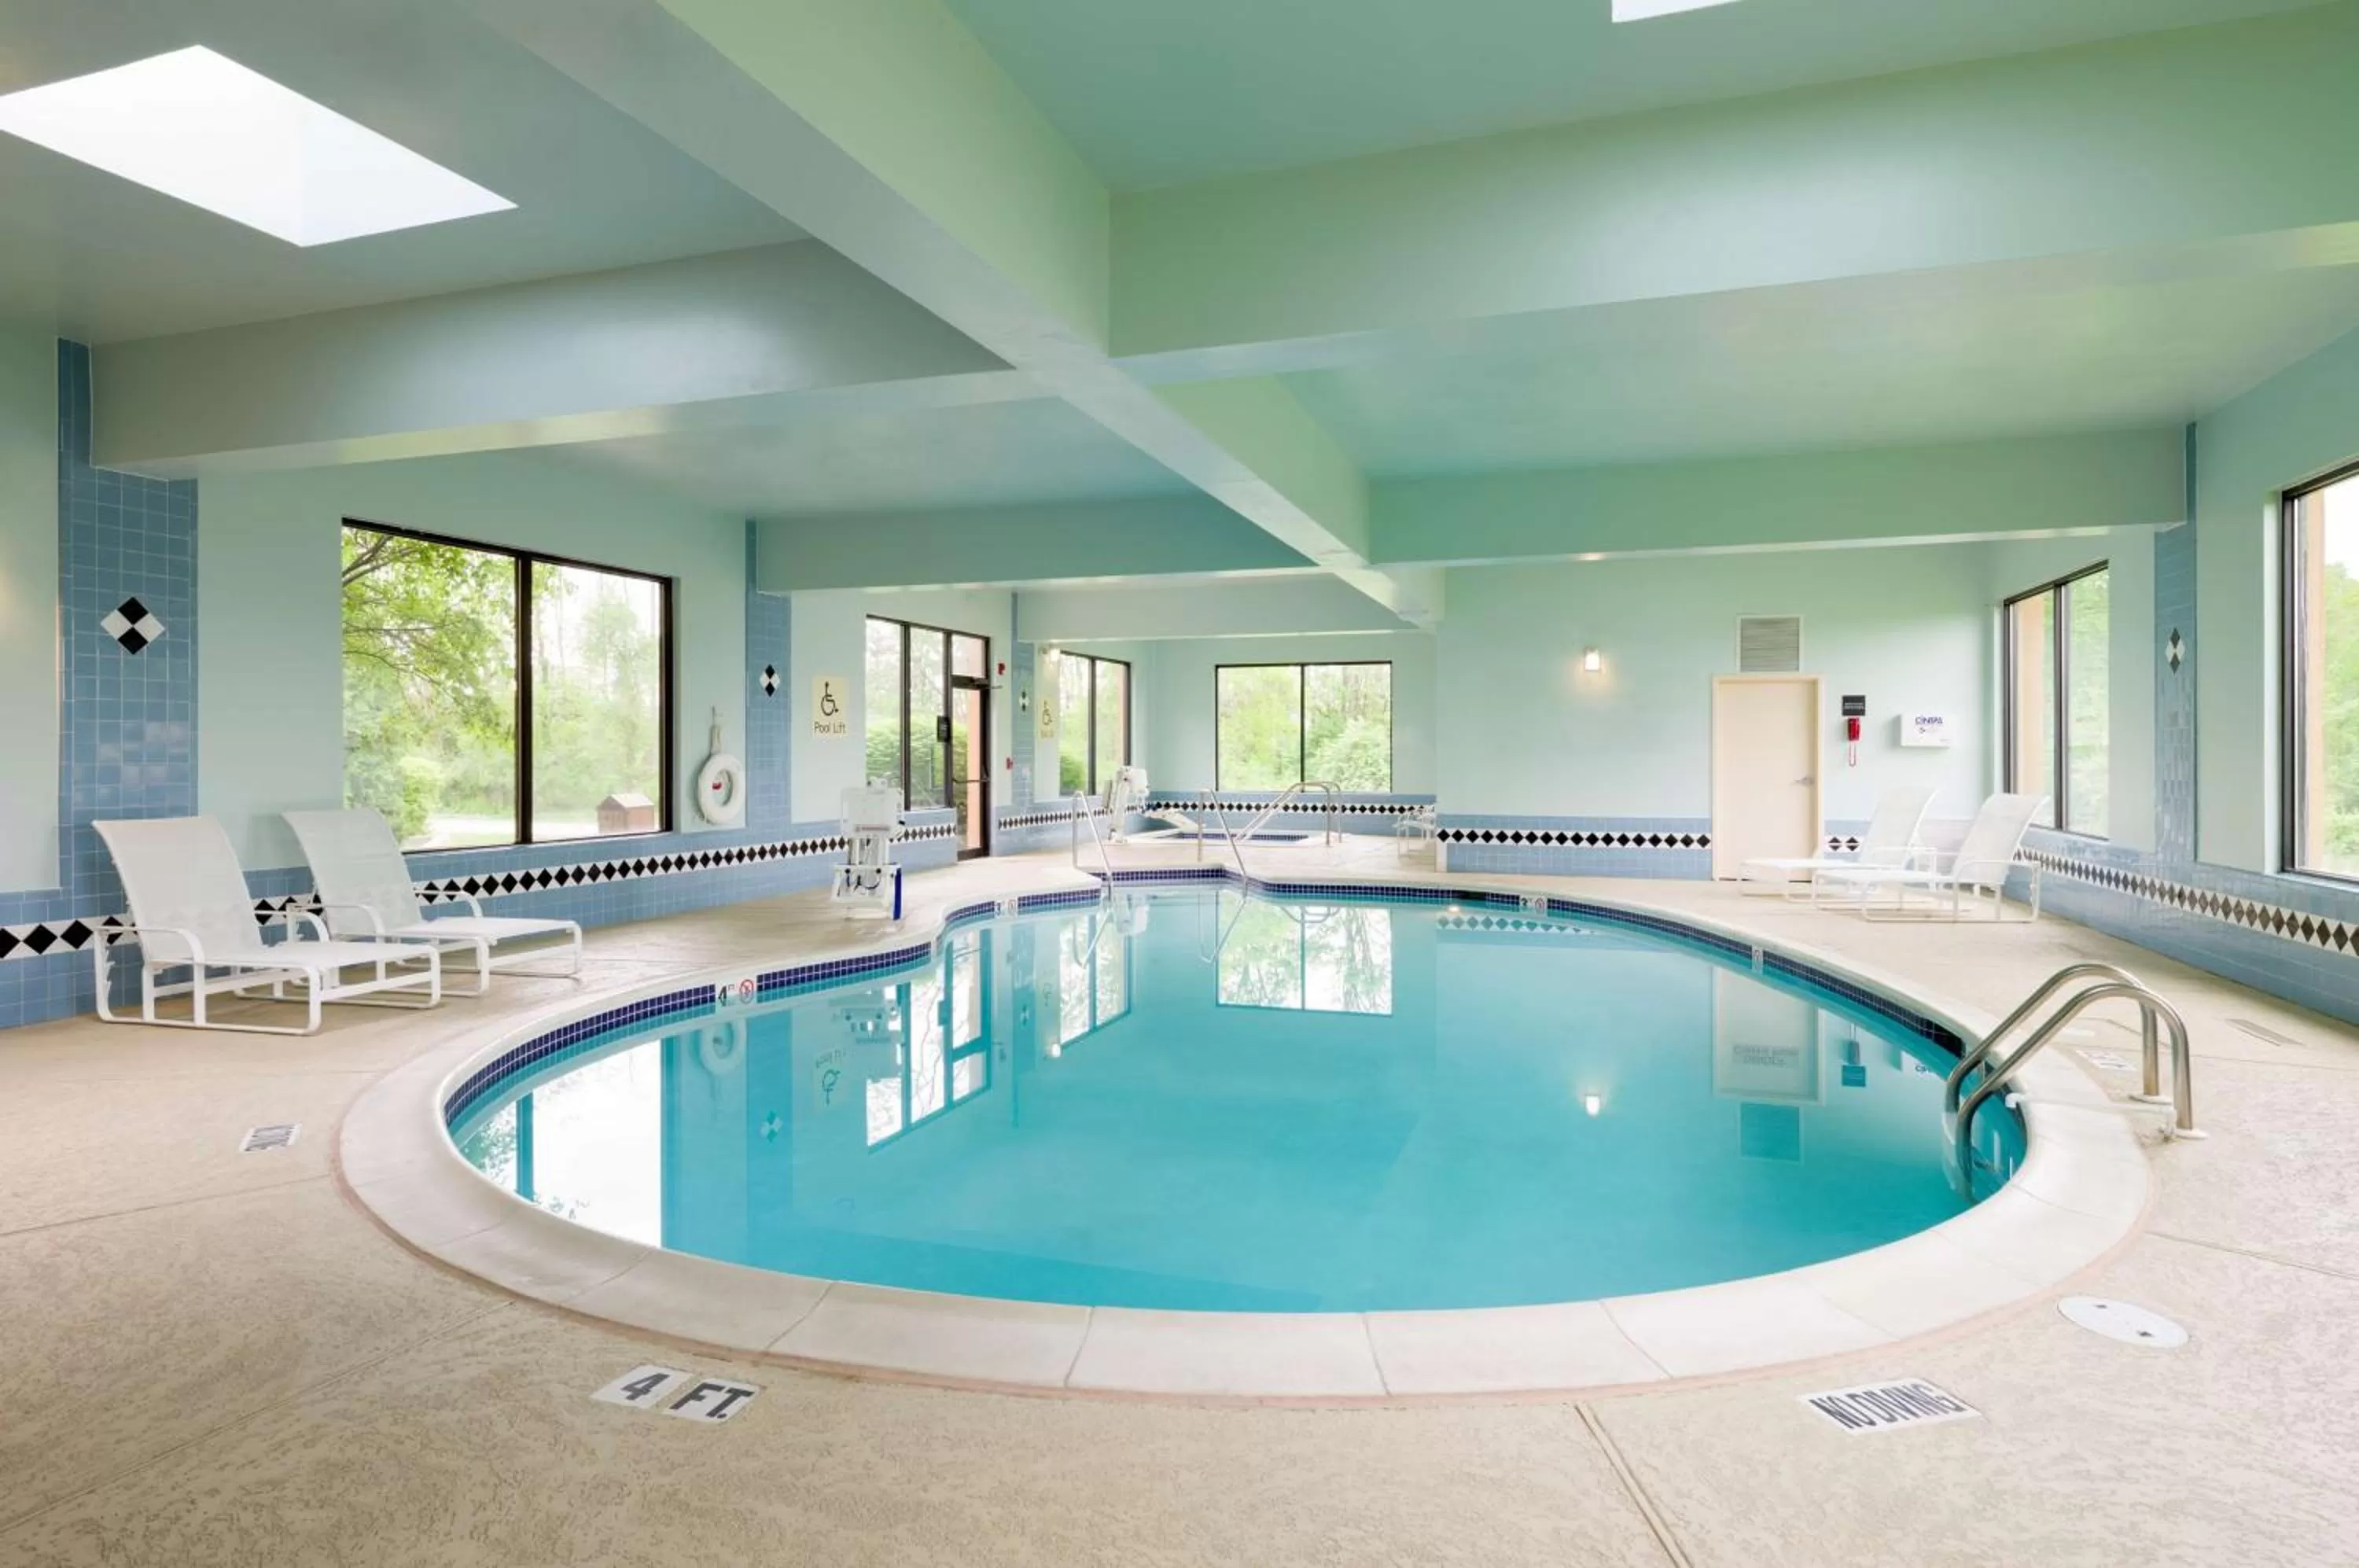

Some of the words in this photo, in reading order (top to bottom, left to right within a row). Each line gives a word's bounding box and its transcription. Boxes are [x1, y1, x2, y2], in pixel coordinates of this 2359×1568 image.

[814, 721, 830, 734] Pool
[620, 1373, 671, 1401] 4
[1809, 1395, 1878, 1430] NO
[1846, 1383, 1967, 1423] DIVING
